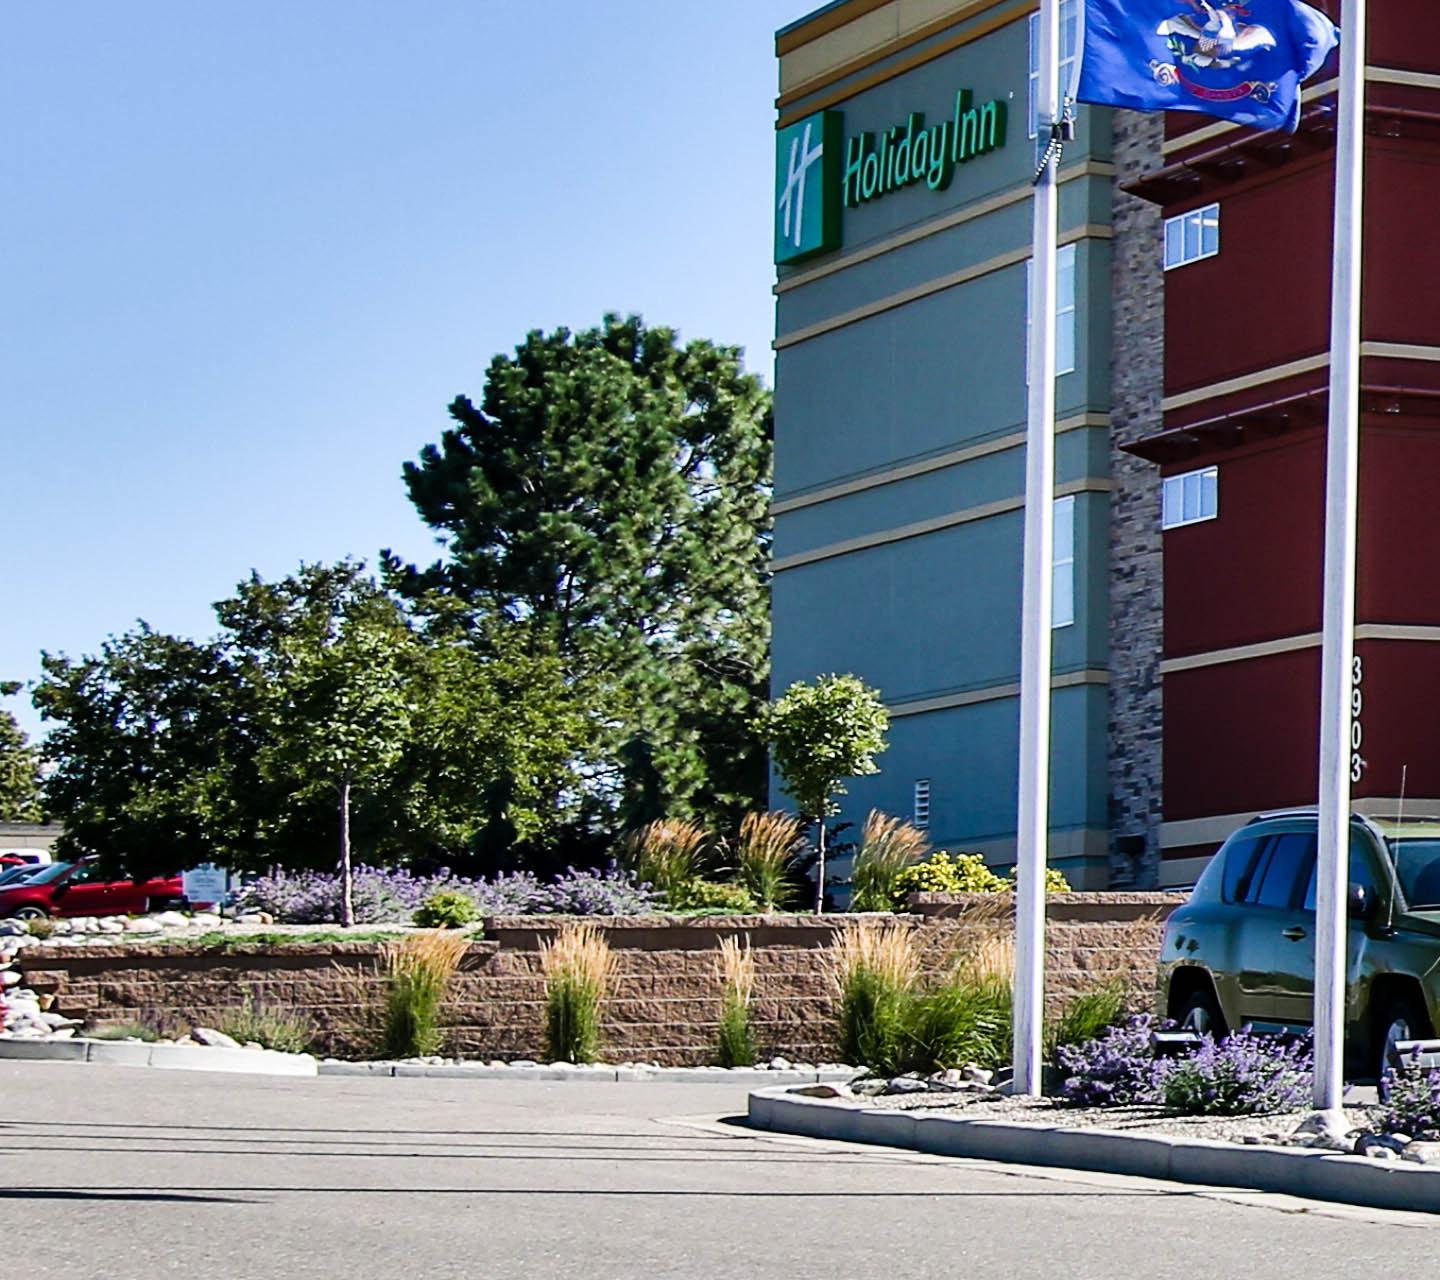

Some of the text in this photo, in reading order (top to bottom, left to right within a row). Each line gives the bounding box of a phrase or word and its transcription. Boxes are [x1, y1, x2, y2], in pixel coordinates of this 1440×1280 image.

[842, 88, 1007, 208] Holiday Inn
[1350, 655, 1363, 783] 3903
